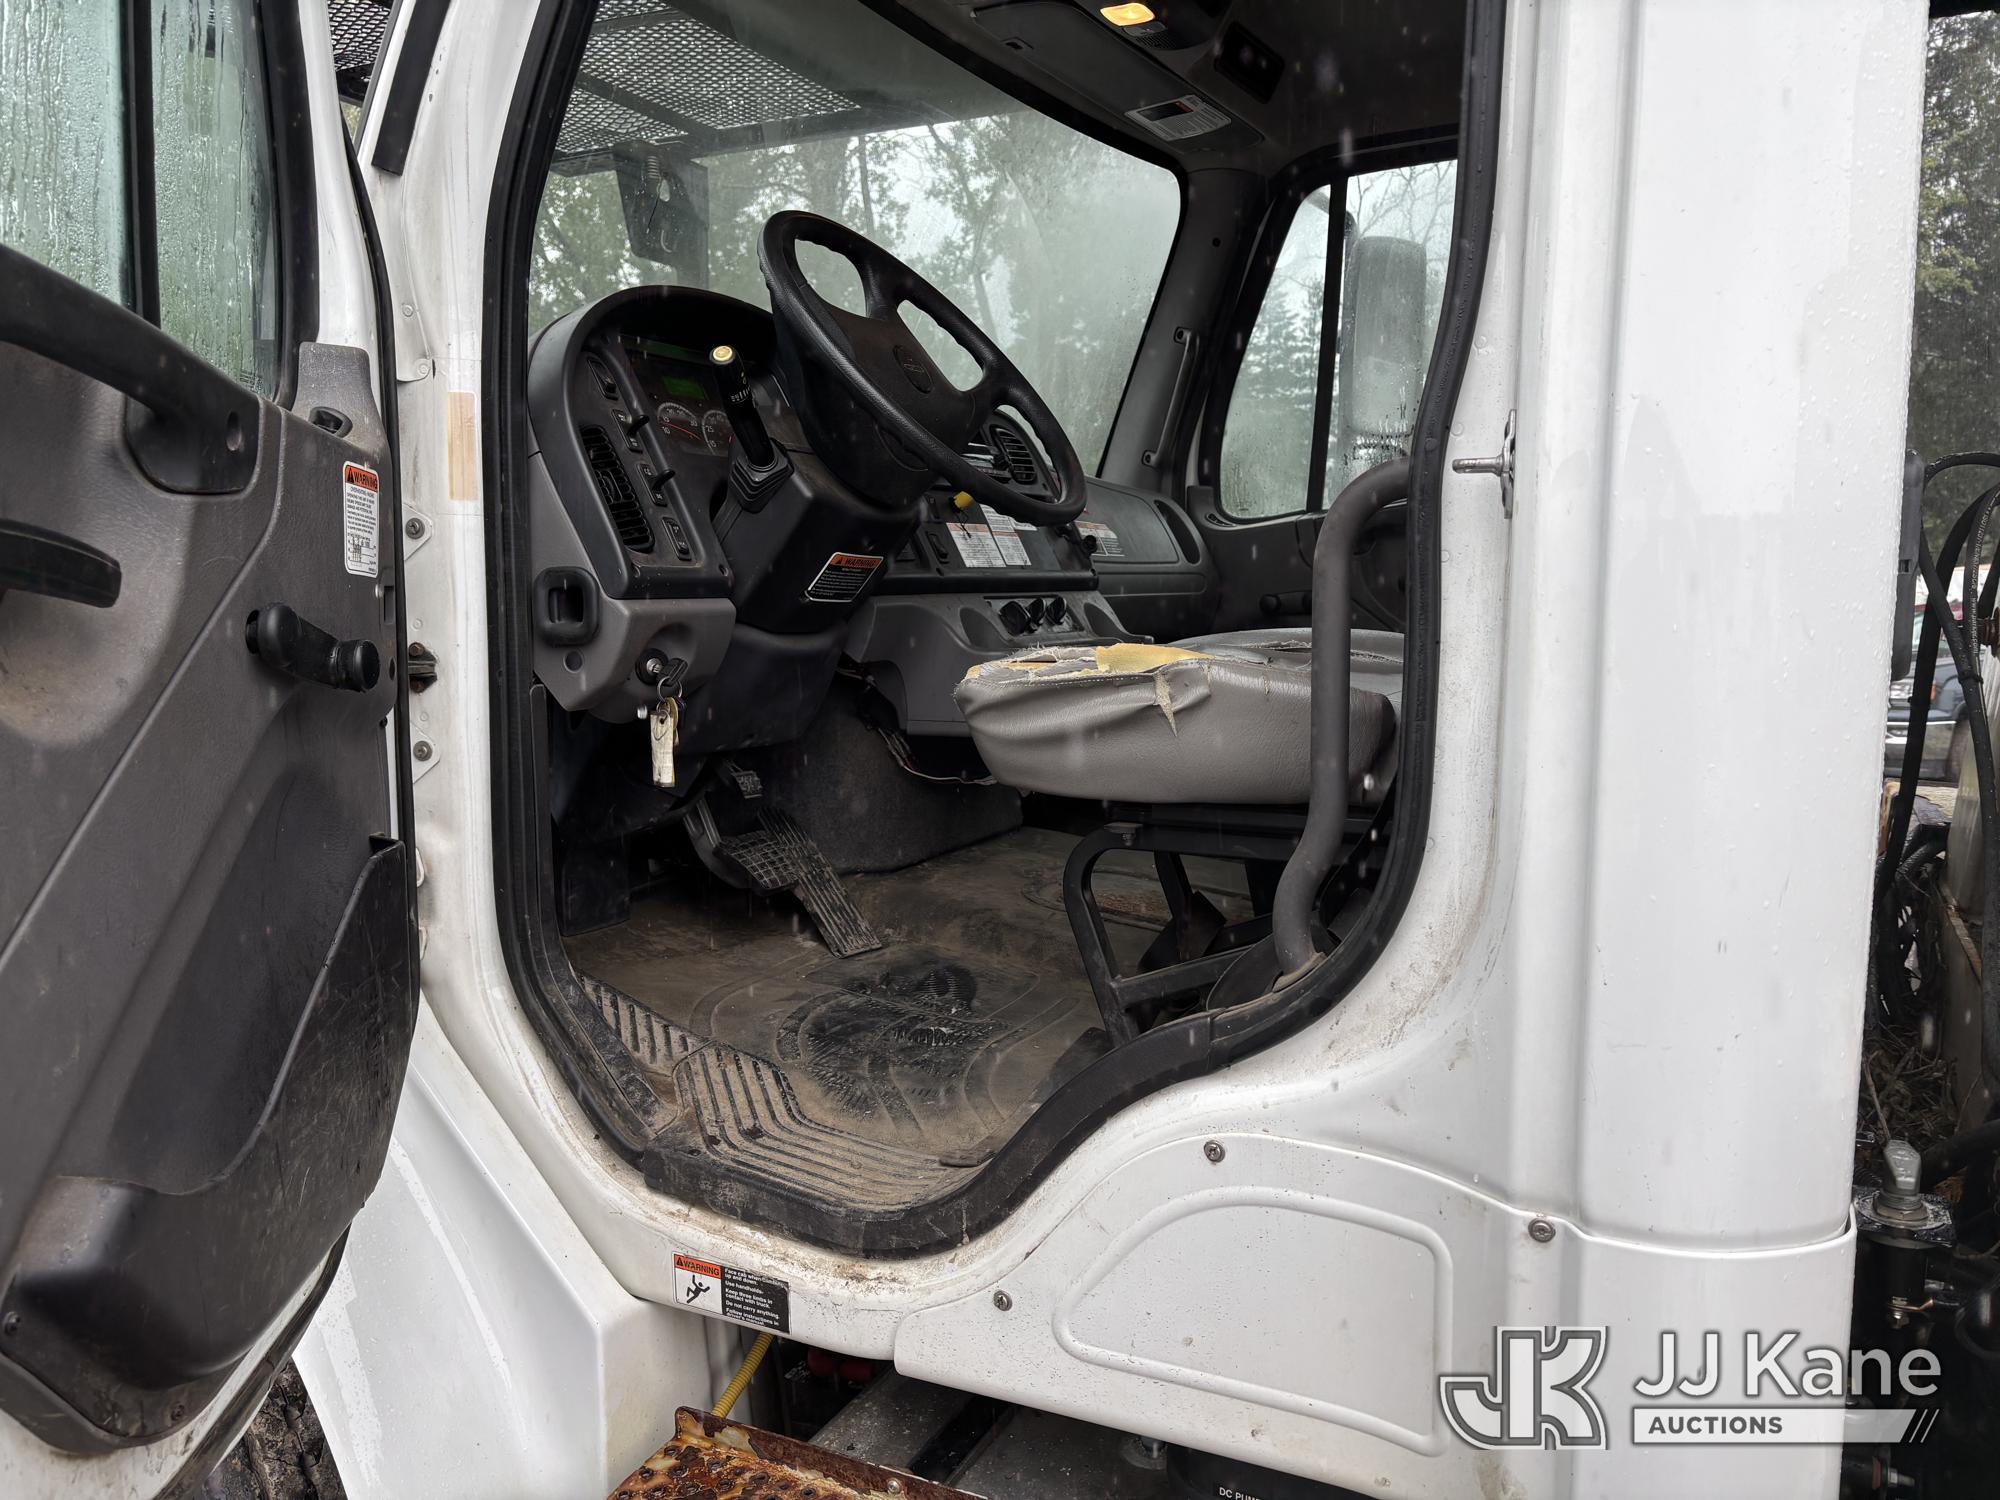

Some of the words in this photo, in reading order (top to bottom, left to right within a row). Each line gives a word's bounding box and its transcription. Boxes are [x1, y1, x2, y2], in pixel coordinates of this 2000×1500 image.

[353, 471, 378, 489] WARNING
[683, 1259, 720, 1276] WARNING
[725, 1268, 737, 1276] Face
[748, 1274, 761, 1282] when
[725, 1280, 735, 1288] Use
[725, 1288, 738, 1297] Keep
[739, 1291, 752, 1299] three
[753, 1294, 767, 1303] limbs
[725, 1293, 744, 1302] contact
[745, 1297, 756, 1305] with
[726, 1307, 742, 1316] Follow
[743, 1312, 773, 1325] instructions
[743, 1305, 756, 1313] carry
[1219, 1487, 1233, 1498] DC
[1235, 1492, 1262, 1500] PU
